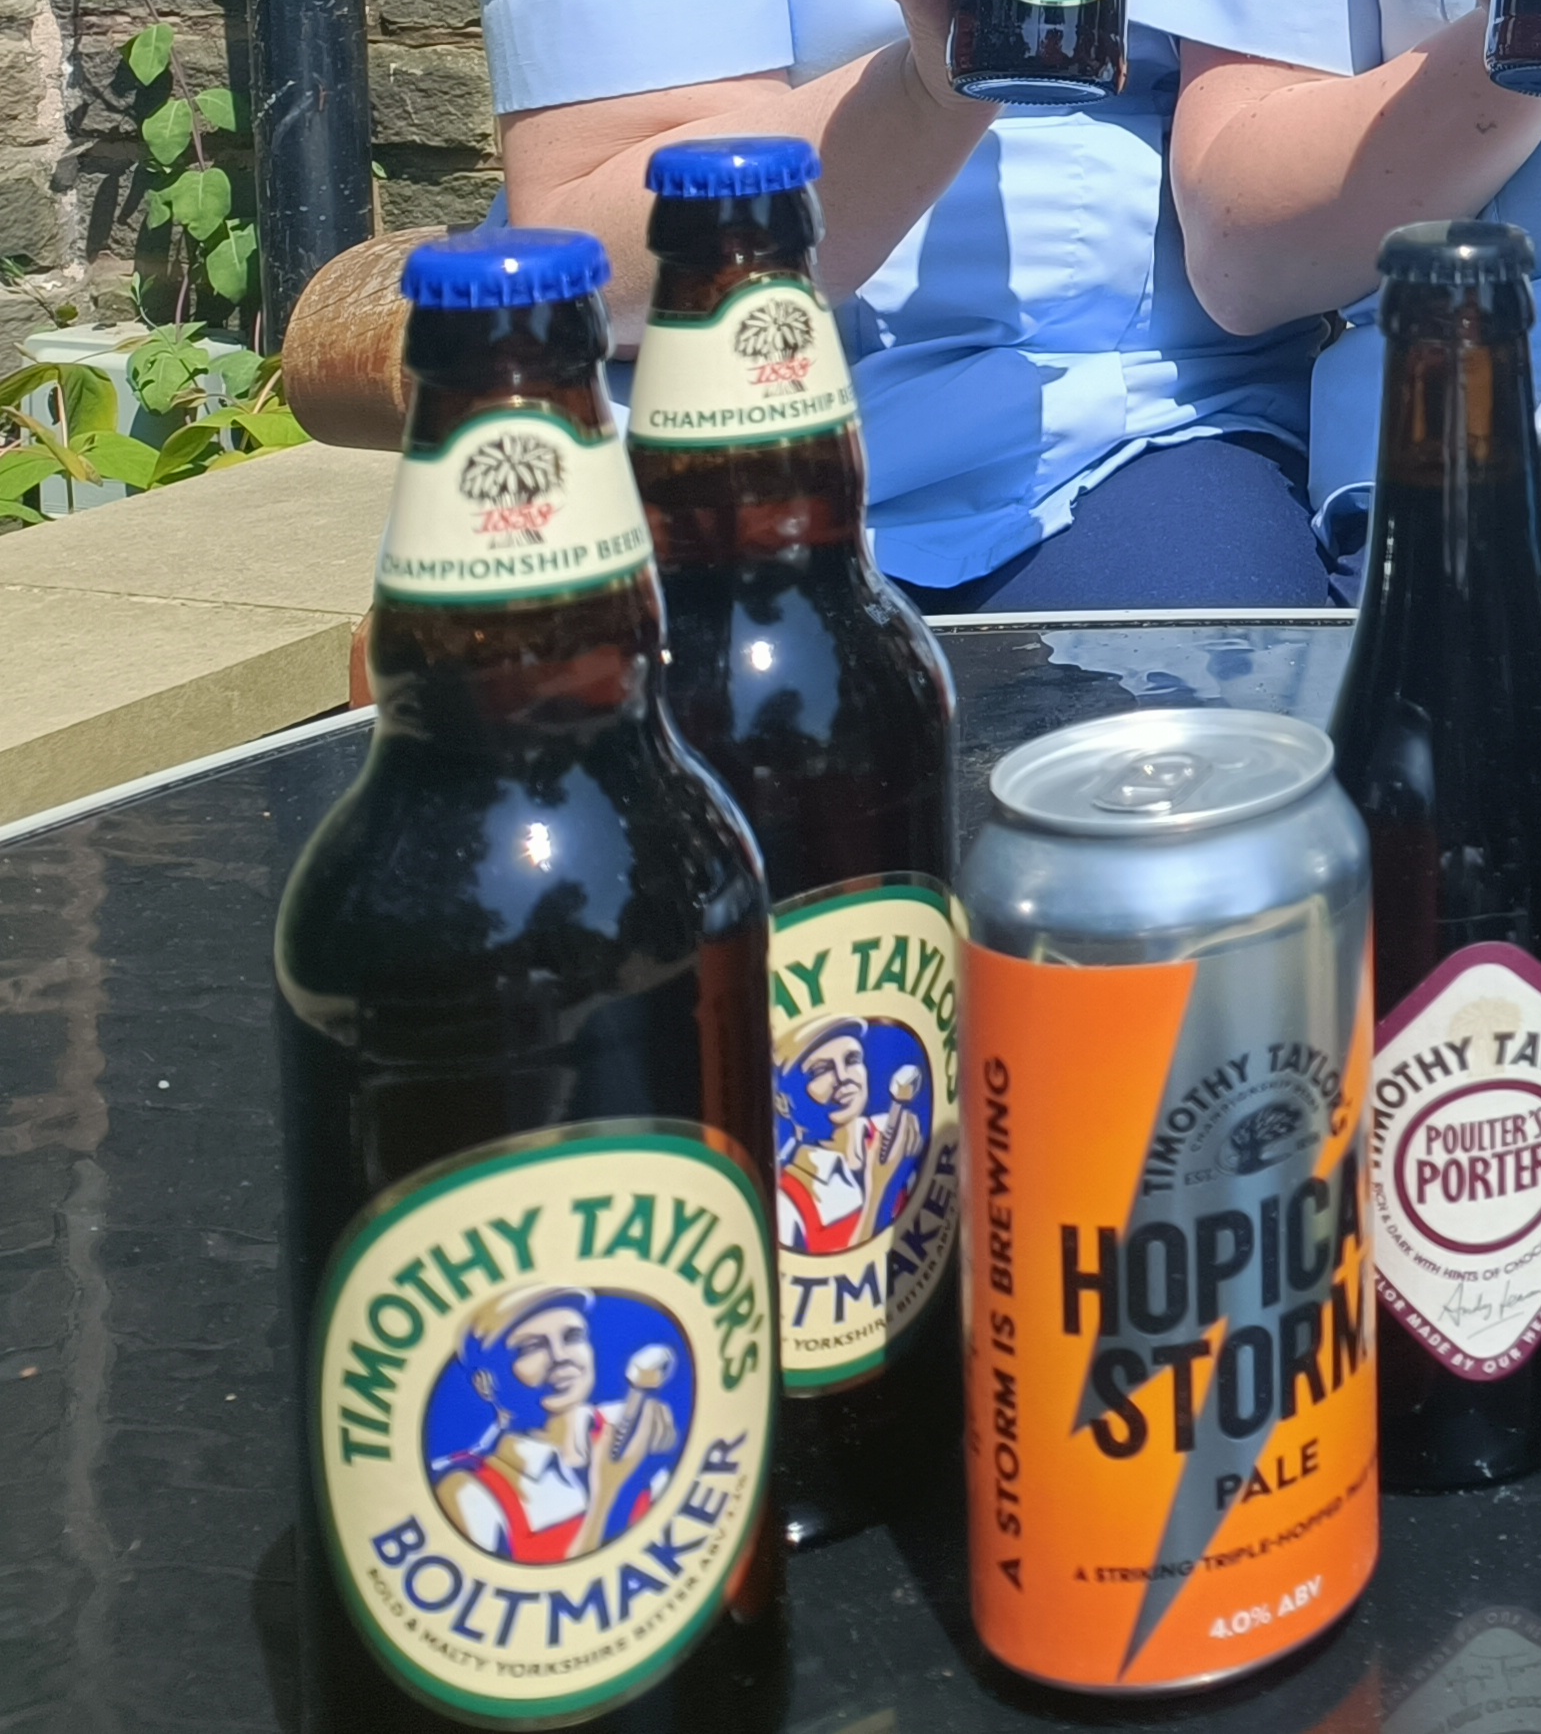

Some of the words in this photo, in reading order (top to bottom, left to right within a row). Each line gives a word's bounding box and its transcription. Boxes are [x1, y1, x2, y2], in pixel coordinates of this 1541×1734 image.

[649, 395, 835, 429] CHAMPIONSHIP
[380, 545, 587, 581] CHAMPIONSHIP
[1142, 1050, 1250, 1198] TIMOTHY
[983, 1056, 1016, 1297] BREWING
[895, 1259, 937, 1314] BITTER
[1386, 1224, 1414, 1257] DARK
[1413, 1251, 1442, 1277] WITH
[1482, 1266, 1501, 1282] OF
[338, 1204, 544, 1467] TIMOTHY
[571, 1192, 766, 1392] TAYLOR'S
[990, 1310, 1017, 1357] IS
[1405, 1312, 1452, 1357] MADE
[1450, 1352, 1476, 1372] BY
[1481, 1344, 1523, 1375] OUR
[1089, 1281, 1369, 1461] STORM
[992, 1367, 1023, 1540] STORM
[1216, 1438, 1320, 1511] PALE
[371, 1429, 748, 1649] BOLTMAKER
[1074, 1566, 1090, 1583] A
[1094, 1559, 1194, 1584] STRIKING
[418, 1627, 492, 1671] MALTY
[495, 1637, 630, 1679] YORKSHIRE
[632, 1574, 702, 1641] BITTER
[698, 1527, 730, 1574] ABV
[998, 1556, 1024, 1593] A
[1208, 1603, 1273, 1640] 4.0%
[1276, 1573, 1325, 1618] ABV
